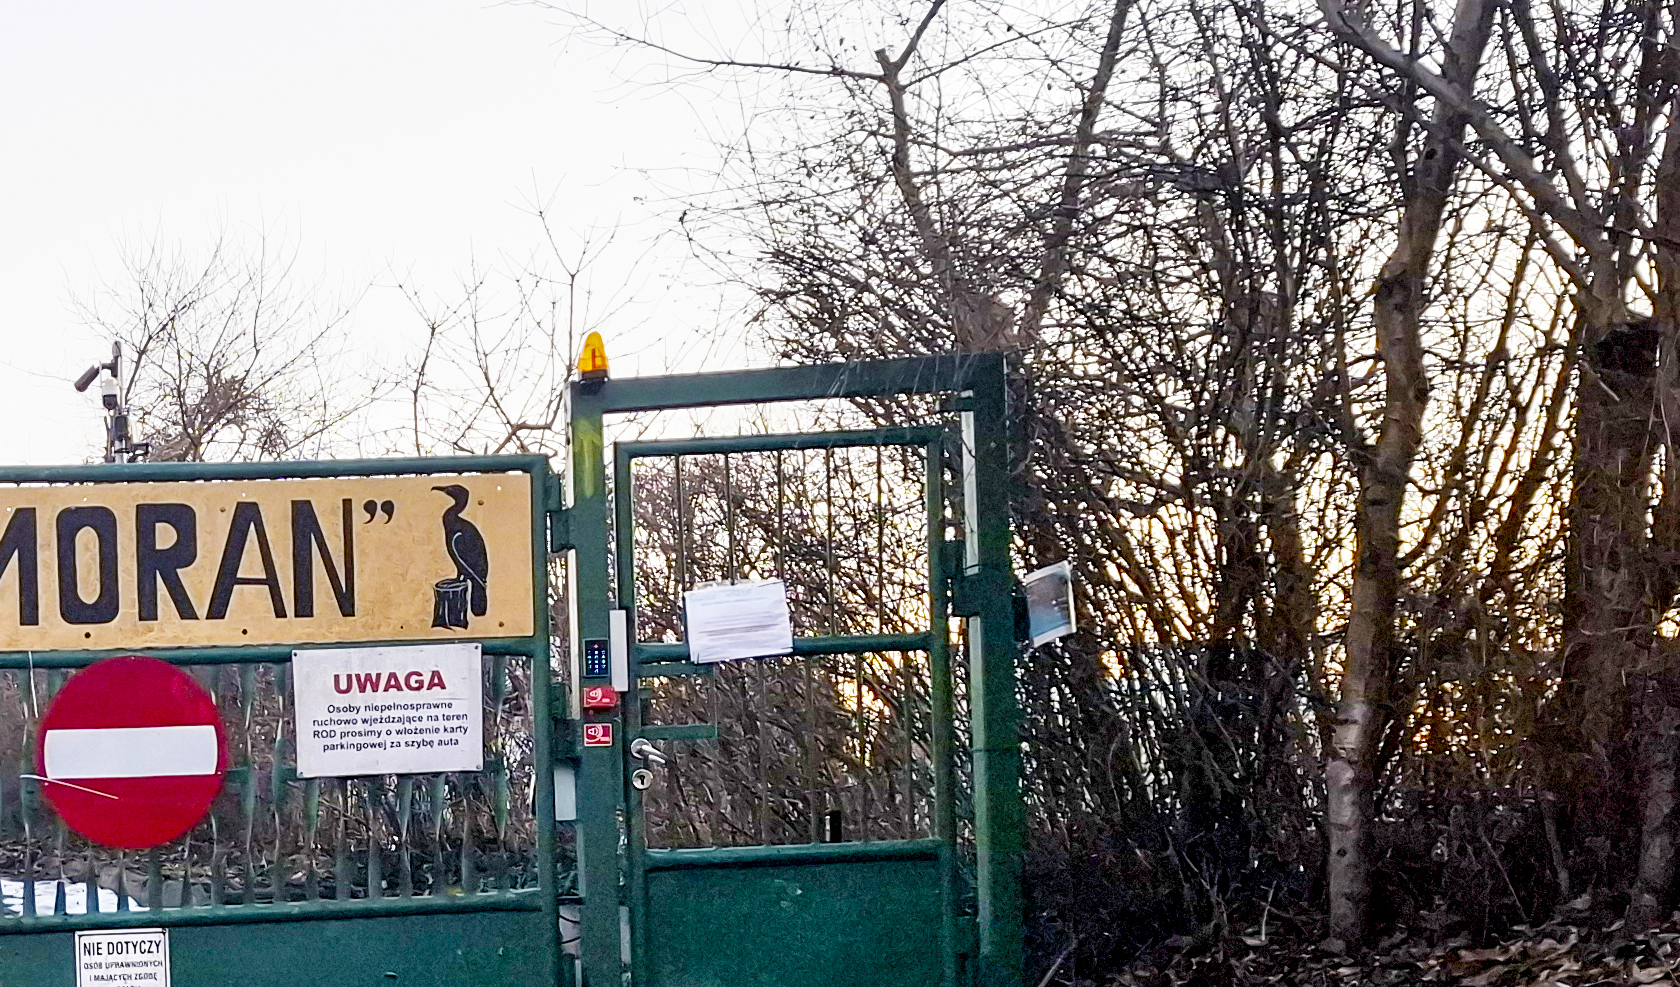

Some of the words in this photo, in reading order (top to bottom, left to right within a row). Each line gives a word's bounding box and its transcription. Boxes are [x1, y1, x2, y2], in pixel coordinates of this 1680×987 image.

[333, 670, 447, 695] UWAGA
[327, 703, 361, 715] Osoby
[312, 717, 358, 727] ruchowo
[426, 714, 439, 722] na
[442, 713, 468, 721] teren
[313, 729, 337, 739] ROD
[340, 728, 382, 740] prosimy
[443, 724, 469, 735] karty
[323, 739, 387, 753] parkingowej
[404, 738, 435, 750] szybę
[437, 737, 459, 746] auta
[83, 941, 103, 957] NIE
[107, 939, 162, 955] DOTYCZY
[83, 961, 103, 970] OSÓB
